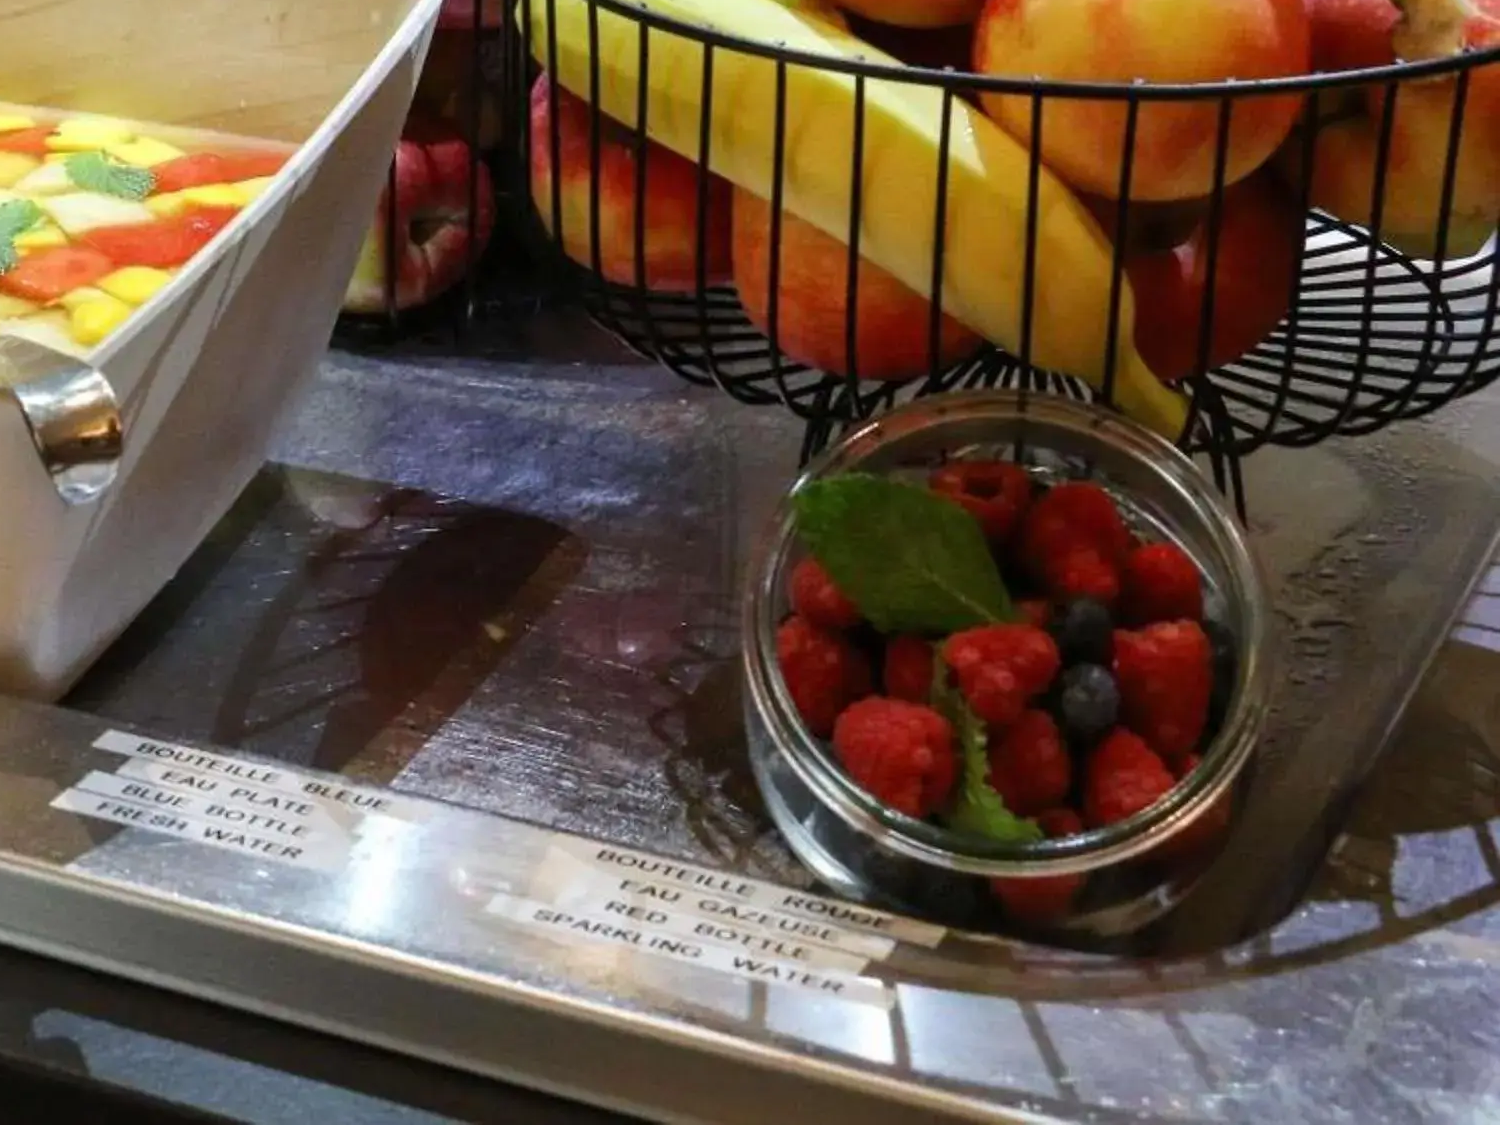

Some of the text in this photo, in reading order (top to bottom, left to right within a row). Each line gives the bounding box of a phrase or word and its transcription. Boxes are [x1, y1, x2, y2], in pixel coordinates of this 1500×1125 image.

[136, 741, 393, 811] BOUTEILLE BLEUE
[161, 770, 315, 816] EAU PLATE
[97, 801, 303, 859] FRESH WATER
[121, 783, 309, 838] BLUE BOTTLE
[596, 849, 895, 930] BOUTEILLE ROUGE
[619, 879, 840, 942] EAU GAZEUSE
[533, 909, 846, 993] SPARKLING WATER
[604, 900, 814, 960] RED BOTTLE
